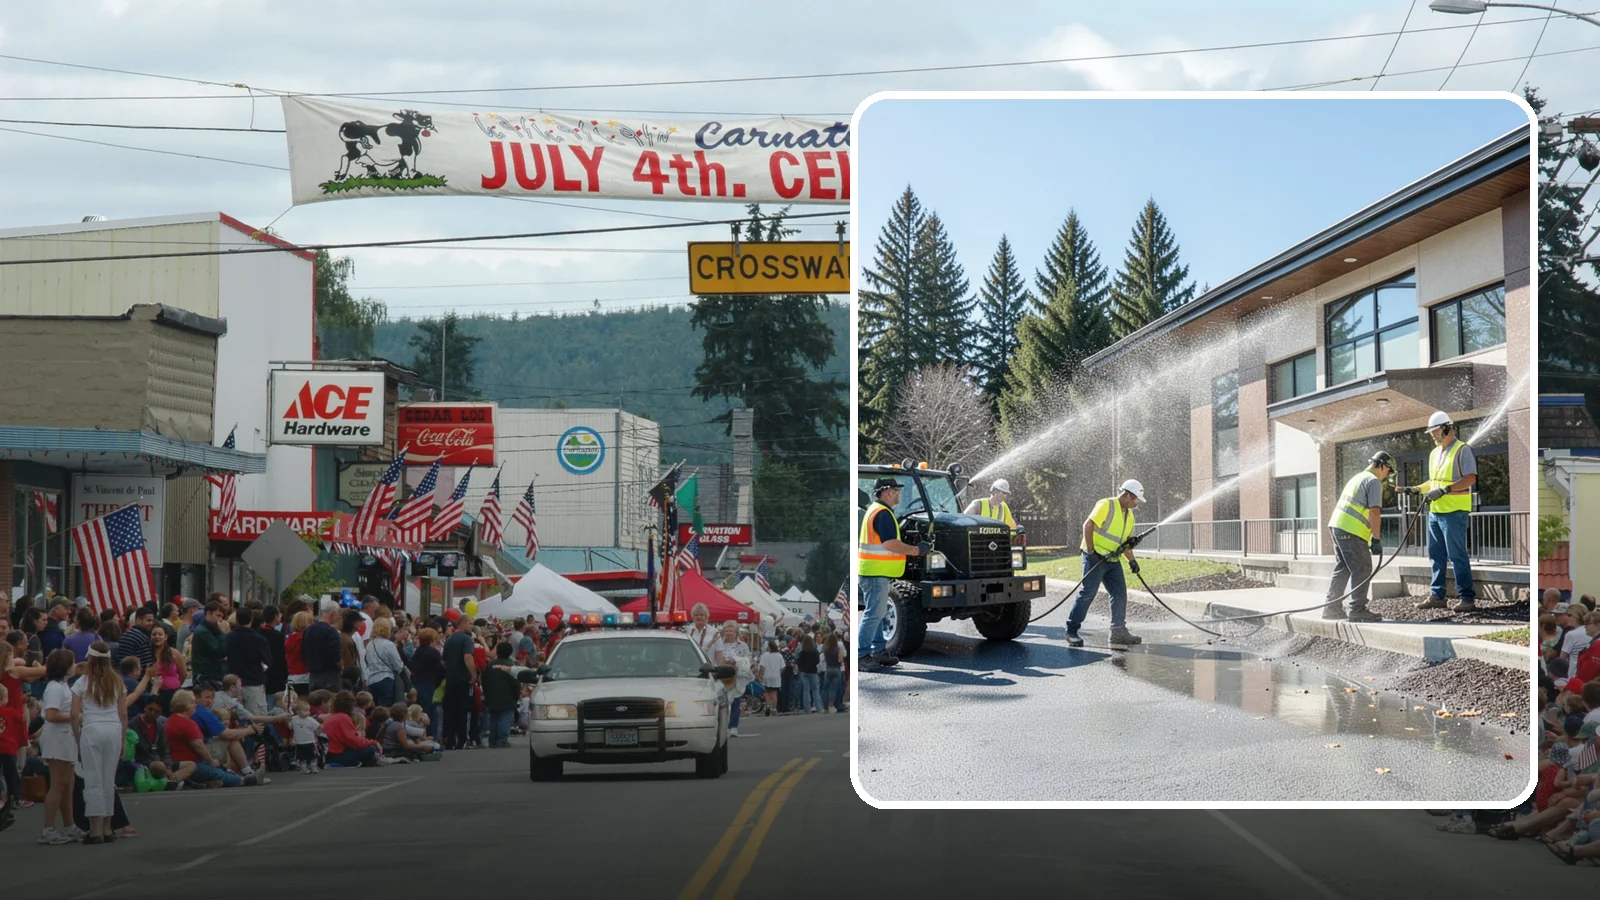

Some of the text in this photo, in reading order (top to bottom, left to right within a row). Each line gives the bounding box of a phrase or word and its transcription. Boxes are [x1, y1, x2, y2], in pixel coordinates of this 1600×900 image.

[695, 121, 850, 150] Carnat
[481, 141, 605, 192] JULY
[632, 150, 746, 198] 4th.
[697, 254, 850, 280] CROSSWA
[283, 380, 373, 420] ACE
[405, 409, 485, 422] CEDAR LOG
[283, 421, 371, 437] Hardware
[353, 467, 385, 480] Simpl
[95, 485, 124, 495] Vincent
[126, 486, 136, 495] de
[137, 486, 155, 495] Paul
[212, 516, 331, 536] HARDARE
[688, 526, 742, 535] CRNATION
[699, 535, 730, 543] GLASS
